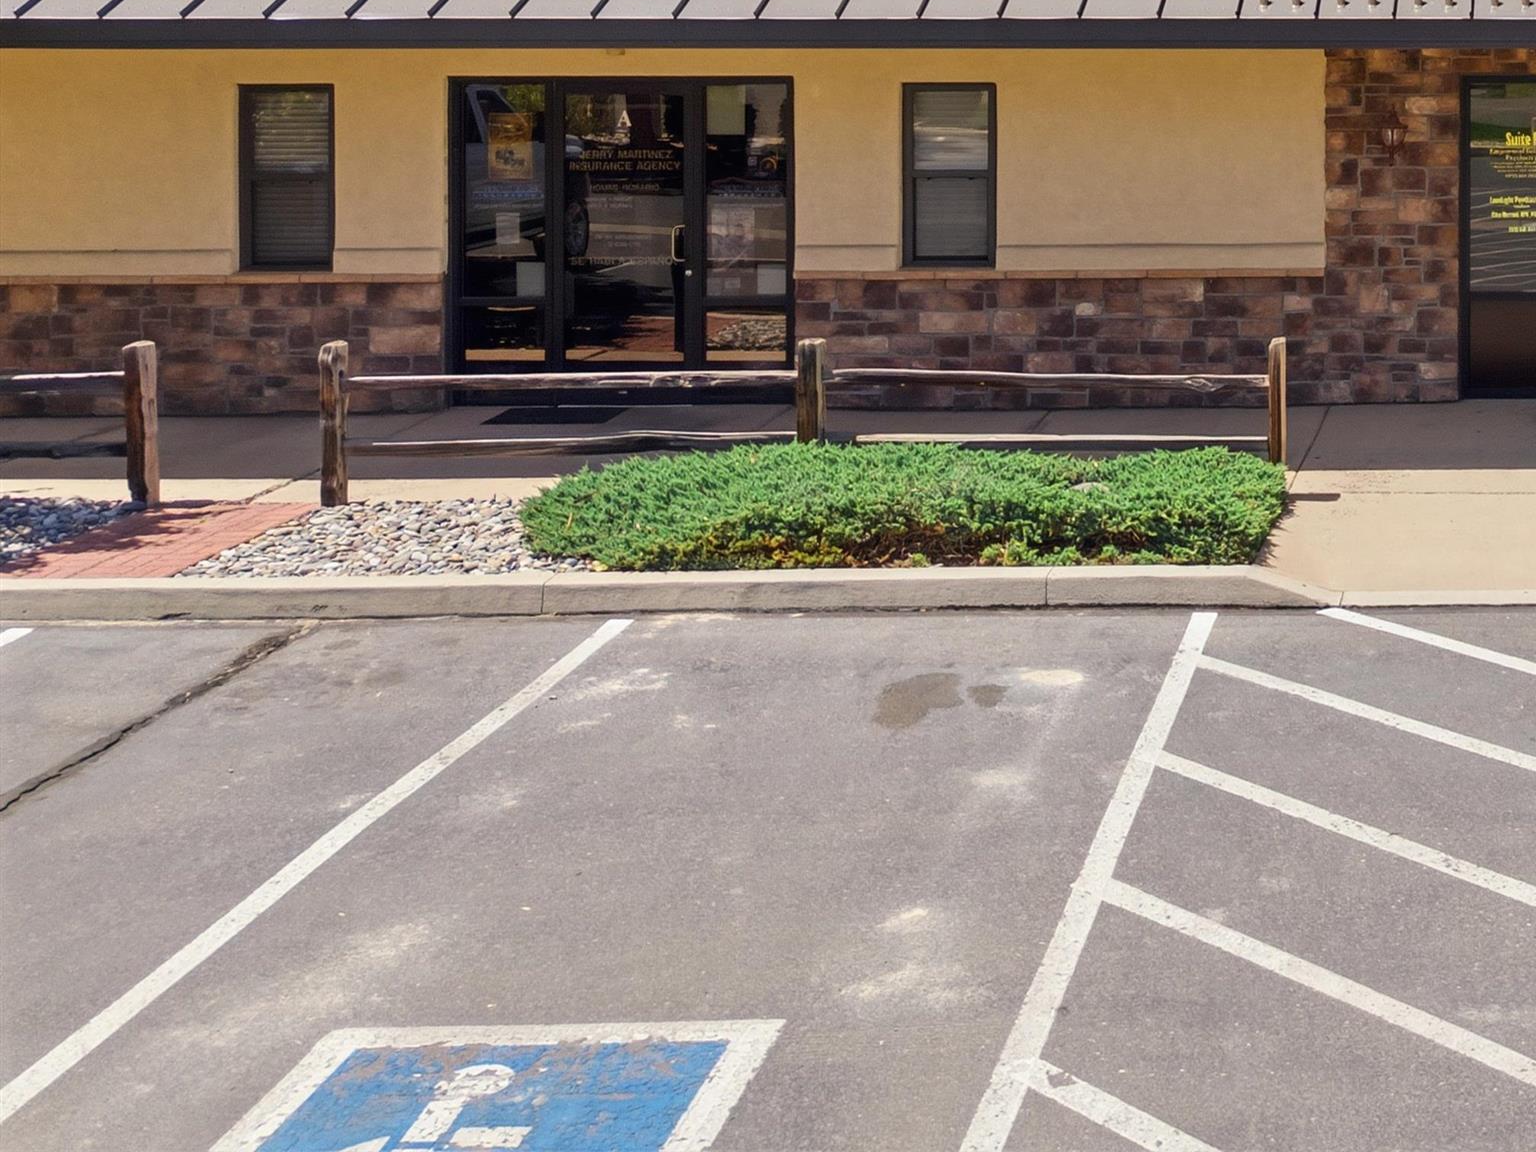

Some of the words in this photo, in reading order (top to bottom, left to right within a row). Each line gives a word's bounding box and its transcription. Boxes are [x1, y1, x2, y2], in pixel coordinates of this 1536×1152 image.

[1505, 131, 1531, 146] Suite
[569, 160, 633, 172] INSURANCE
[636, 161, 681, 172] AGENCY
